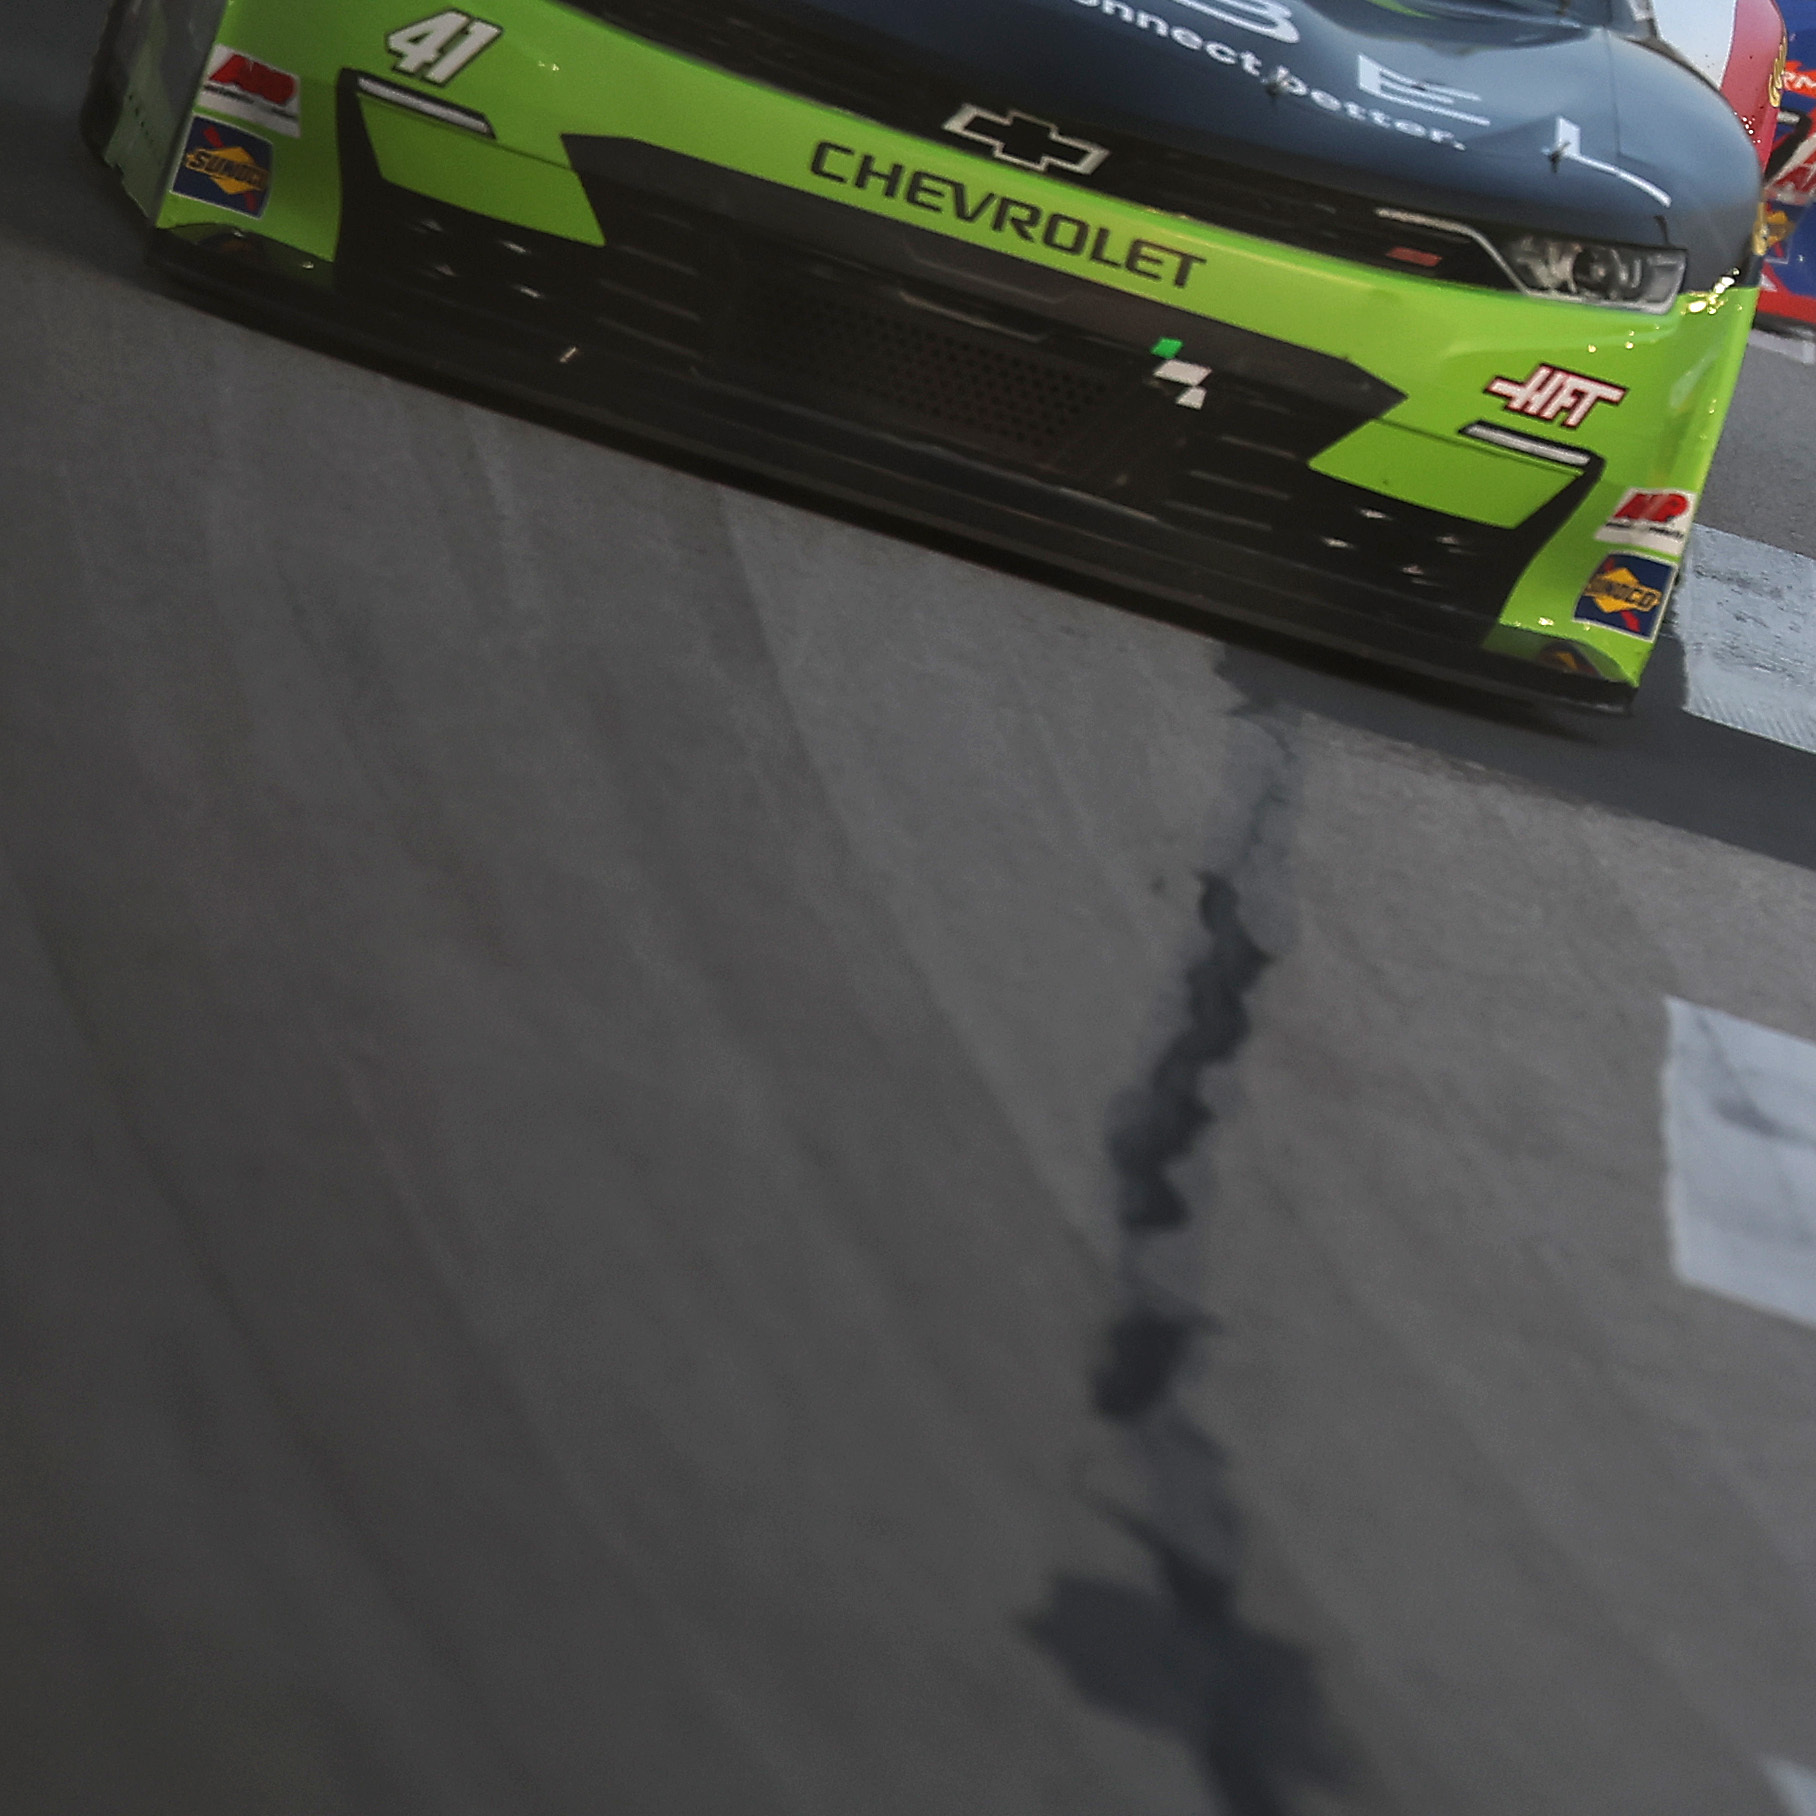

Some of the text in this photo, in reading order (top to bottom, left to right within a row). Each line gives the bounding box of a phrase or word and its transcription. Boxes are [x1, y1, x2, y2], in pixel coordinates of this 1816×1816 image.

[386, 8, 502, 86] 41
[1273, 66, 1468, 151] better.
[810, 141, 1207, 289] CHEVROLET
